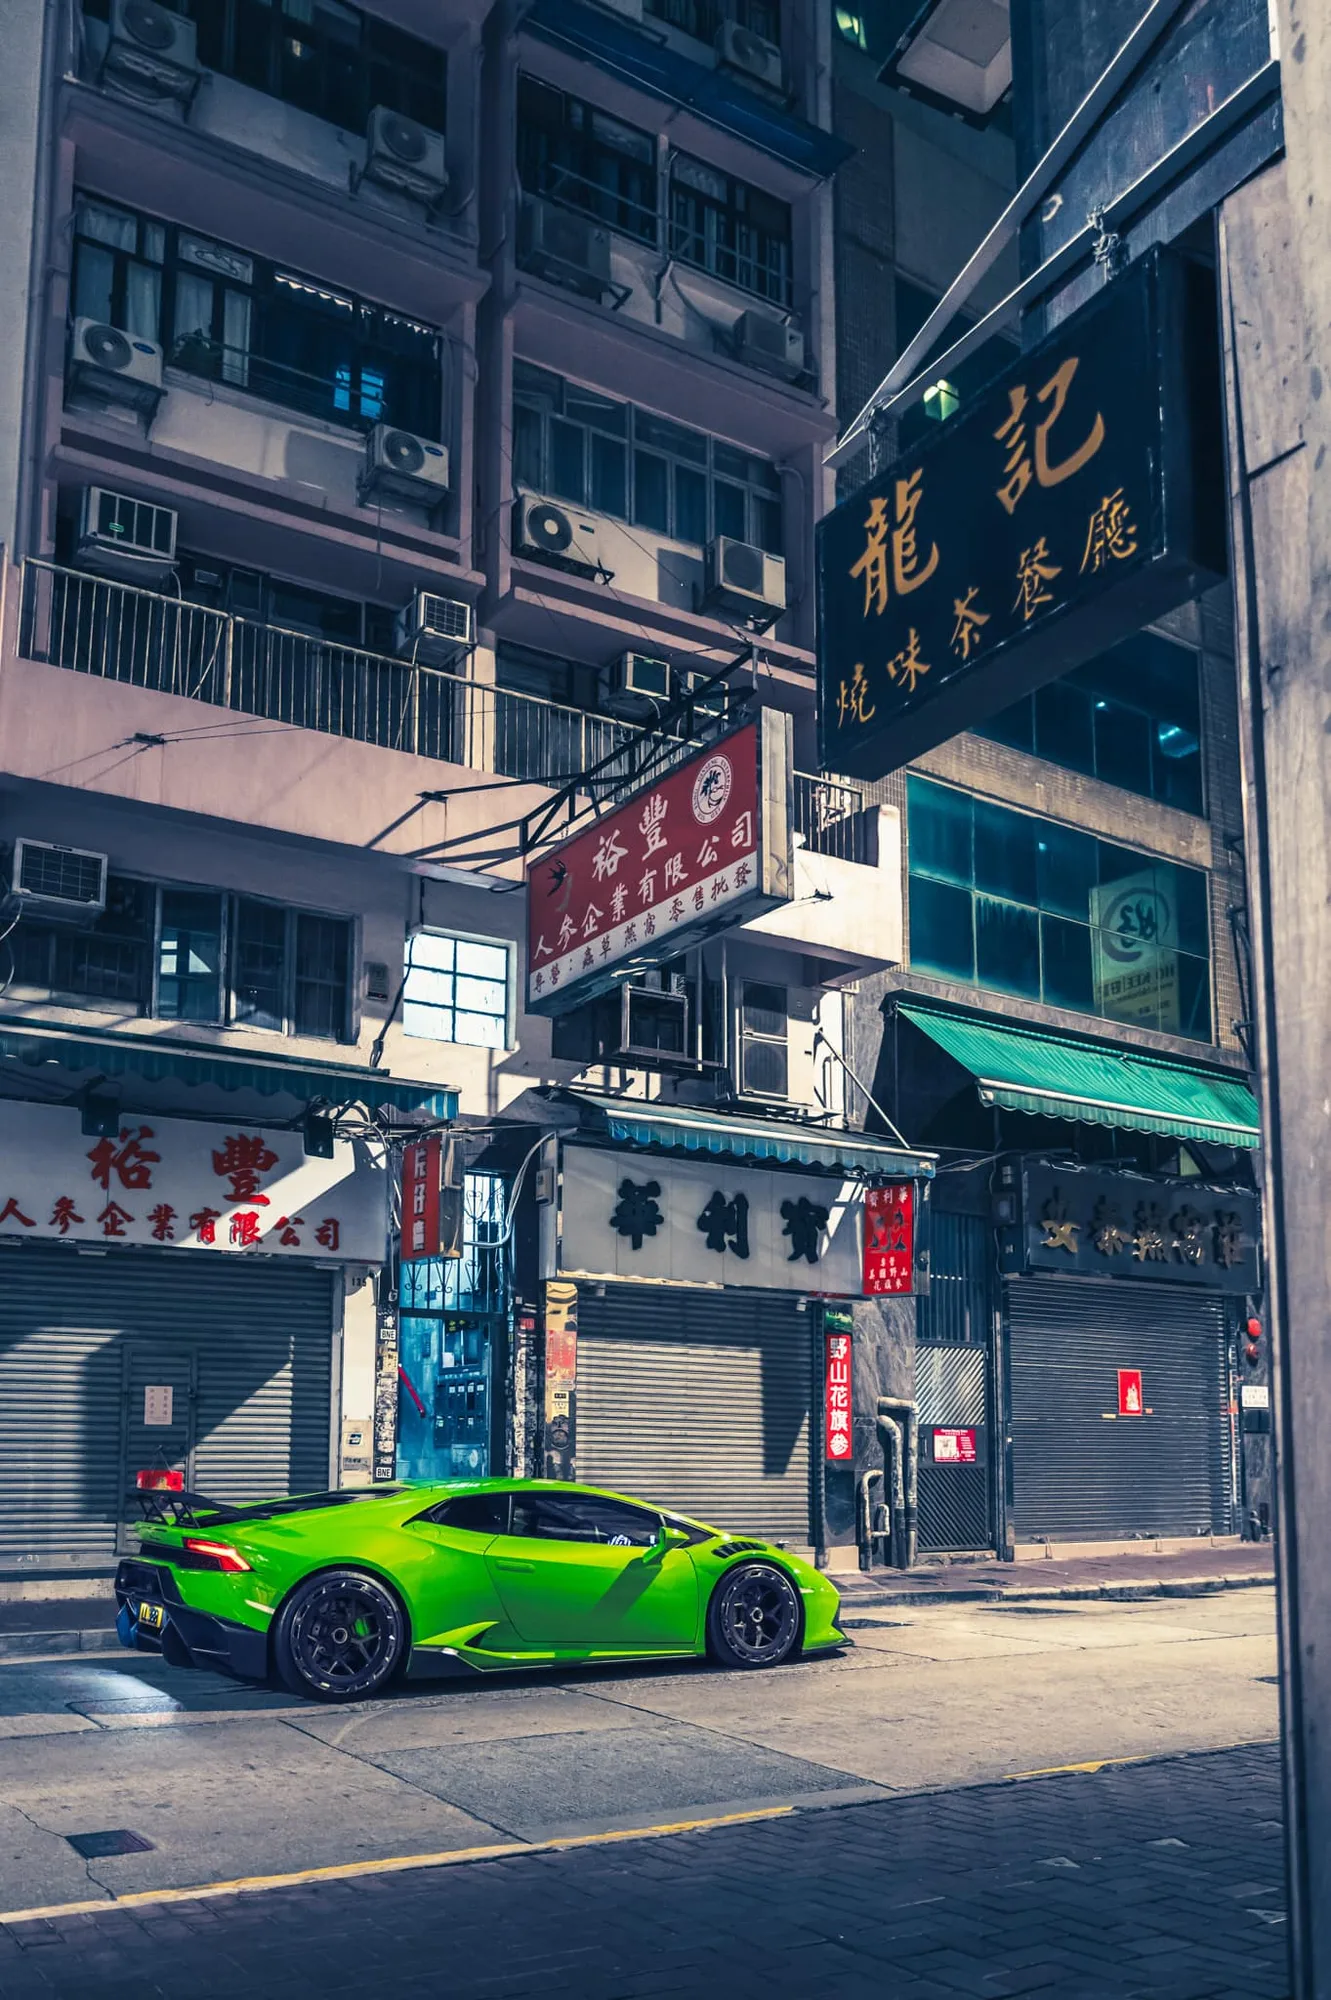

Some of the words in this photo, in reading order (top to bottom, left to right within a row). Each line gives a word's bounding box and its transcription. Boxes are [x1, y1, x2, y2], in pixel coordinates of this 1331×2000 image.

[848, 357, 1105, 618] 龍記
[837, 487, 1139, 728] 燒味茶餐廳
[592, 793, 669, 882] 裕豐
[86, 1125, 280, 1207] 裕豐
[381, 1329, 397, 1339] BNE
[829, 1337, 850, 1456] 野山花旗參
[377, 1468, 392, 1477] BNE
